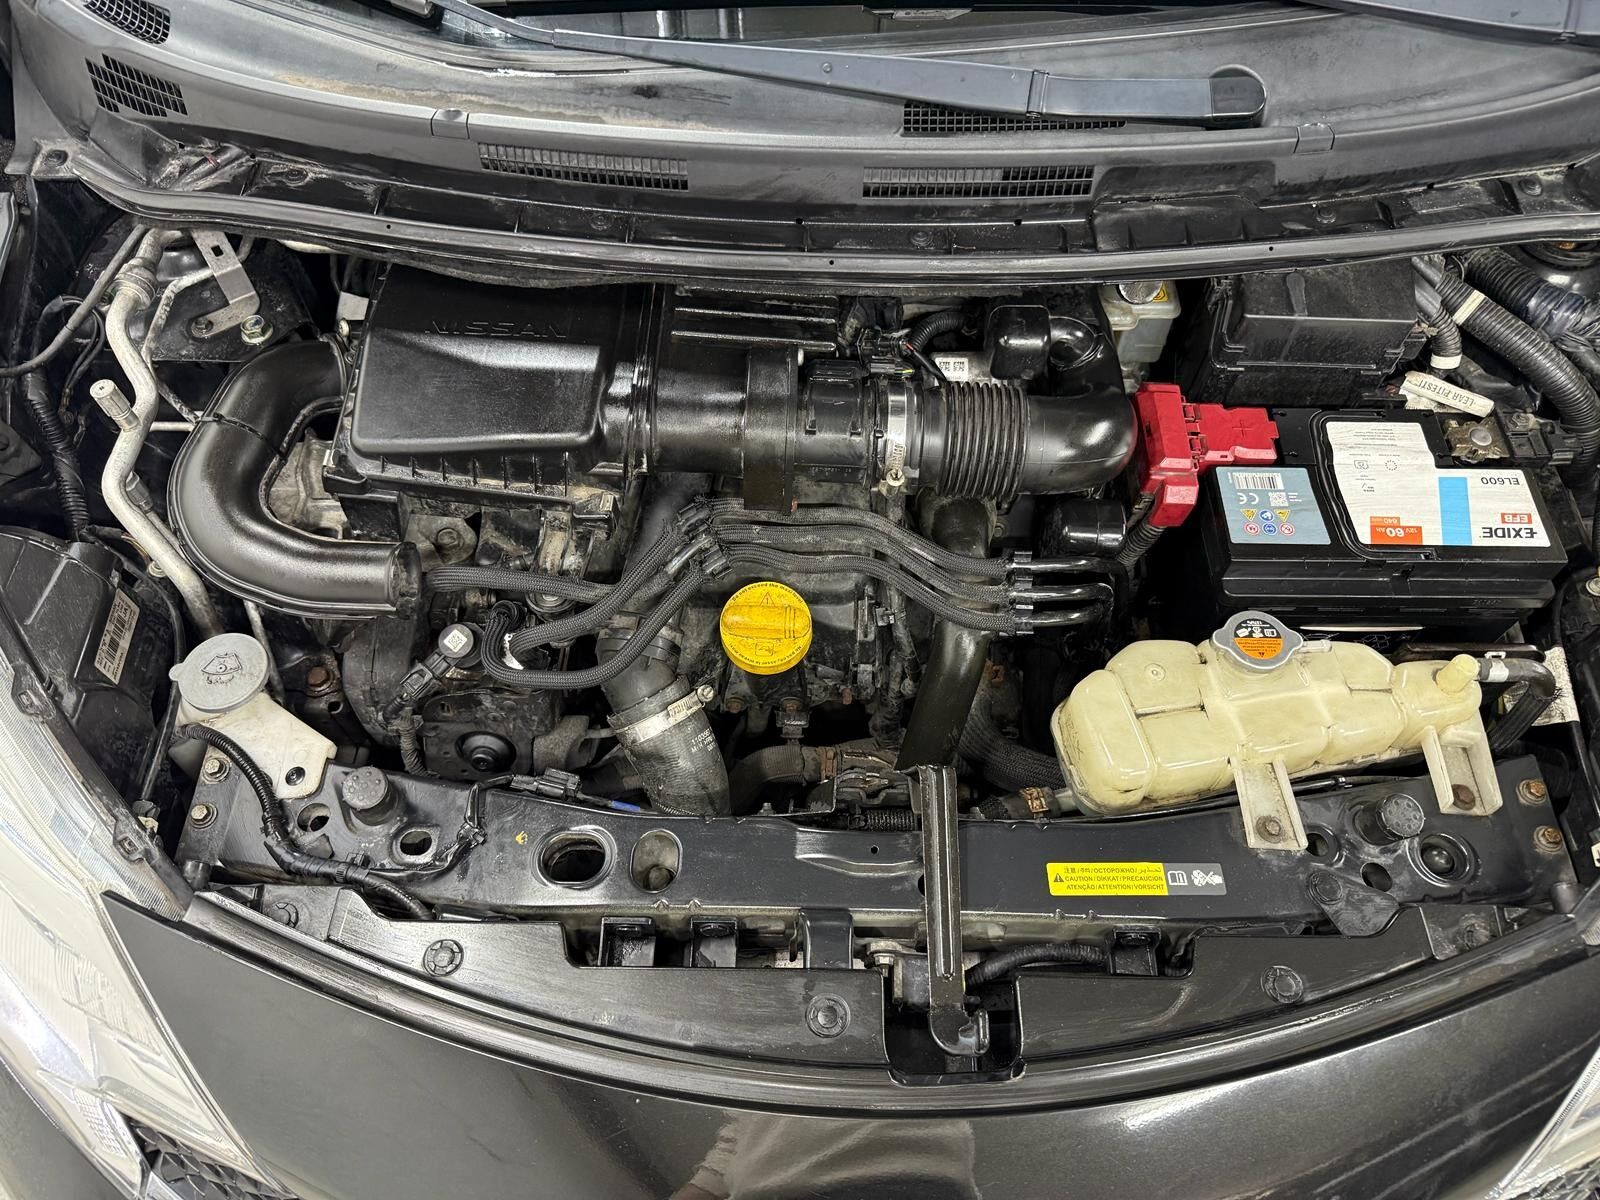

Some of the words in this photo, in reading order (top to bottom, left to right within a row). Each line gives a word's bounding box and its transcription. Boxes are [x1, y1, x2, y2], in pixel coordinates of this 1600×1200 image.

[424, 319, 567, 339] NISSAN
[1452, 392, 1475, 407] LEAR
[1480, 476, 1520, 486] EL600
[1504, 514, 1529, 522] EFB
[1386, 527, 1404, 538] 60
[1482, 526, 1538, 539] EXIDE
